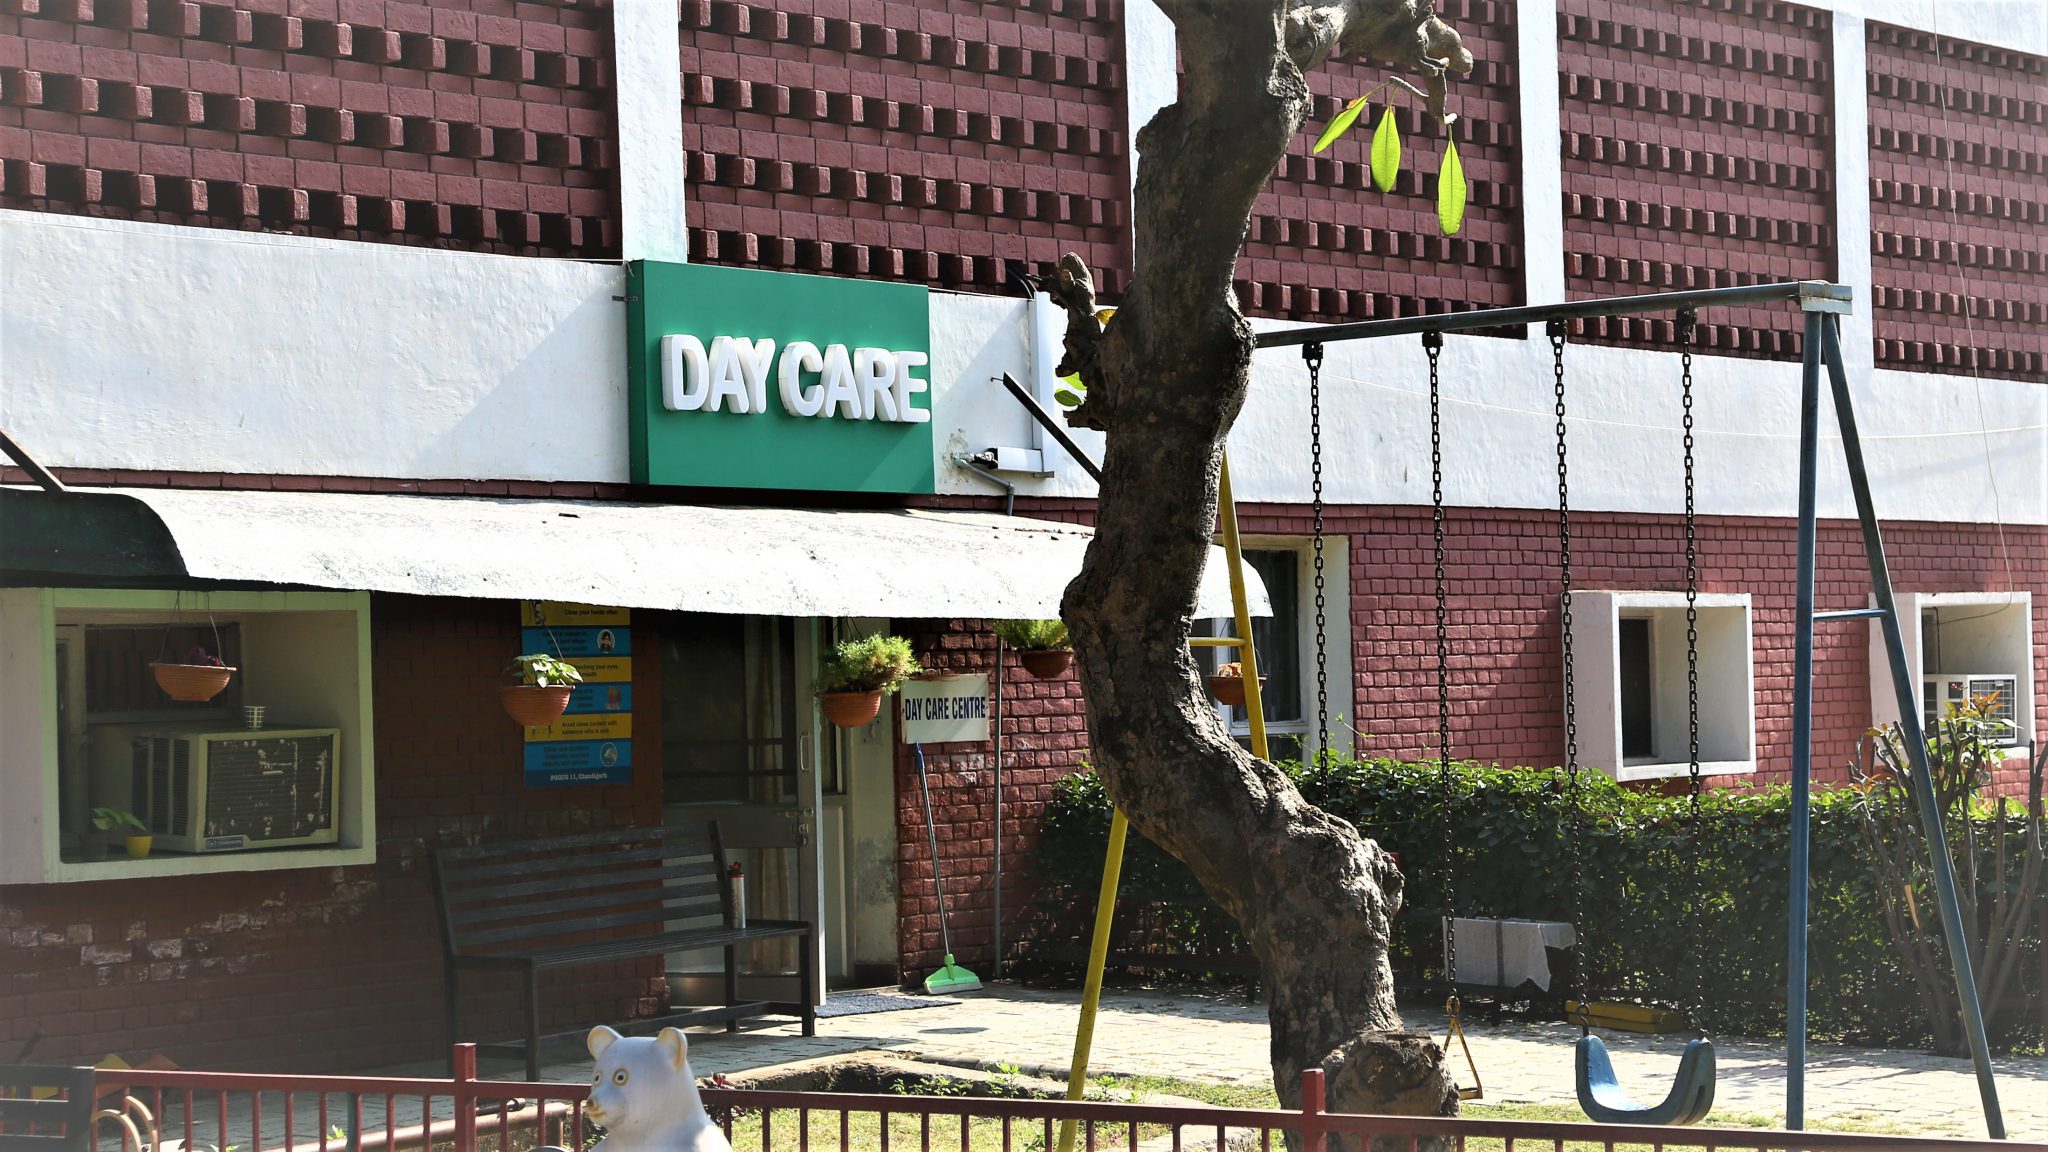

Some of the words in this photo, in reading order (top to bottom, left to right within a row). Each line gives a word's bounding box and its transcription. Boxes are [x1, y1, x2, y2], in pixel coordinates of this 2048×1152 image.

[661, 334, 776, 414] DAY
[778, 341, 931, 423] CARE
[905, 698, 922, 720] DAY
[926, 697, 949, 720] CARE
[952, 696, 986, 719] CENTRE
